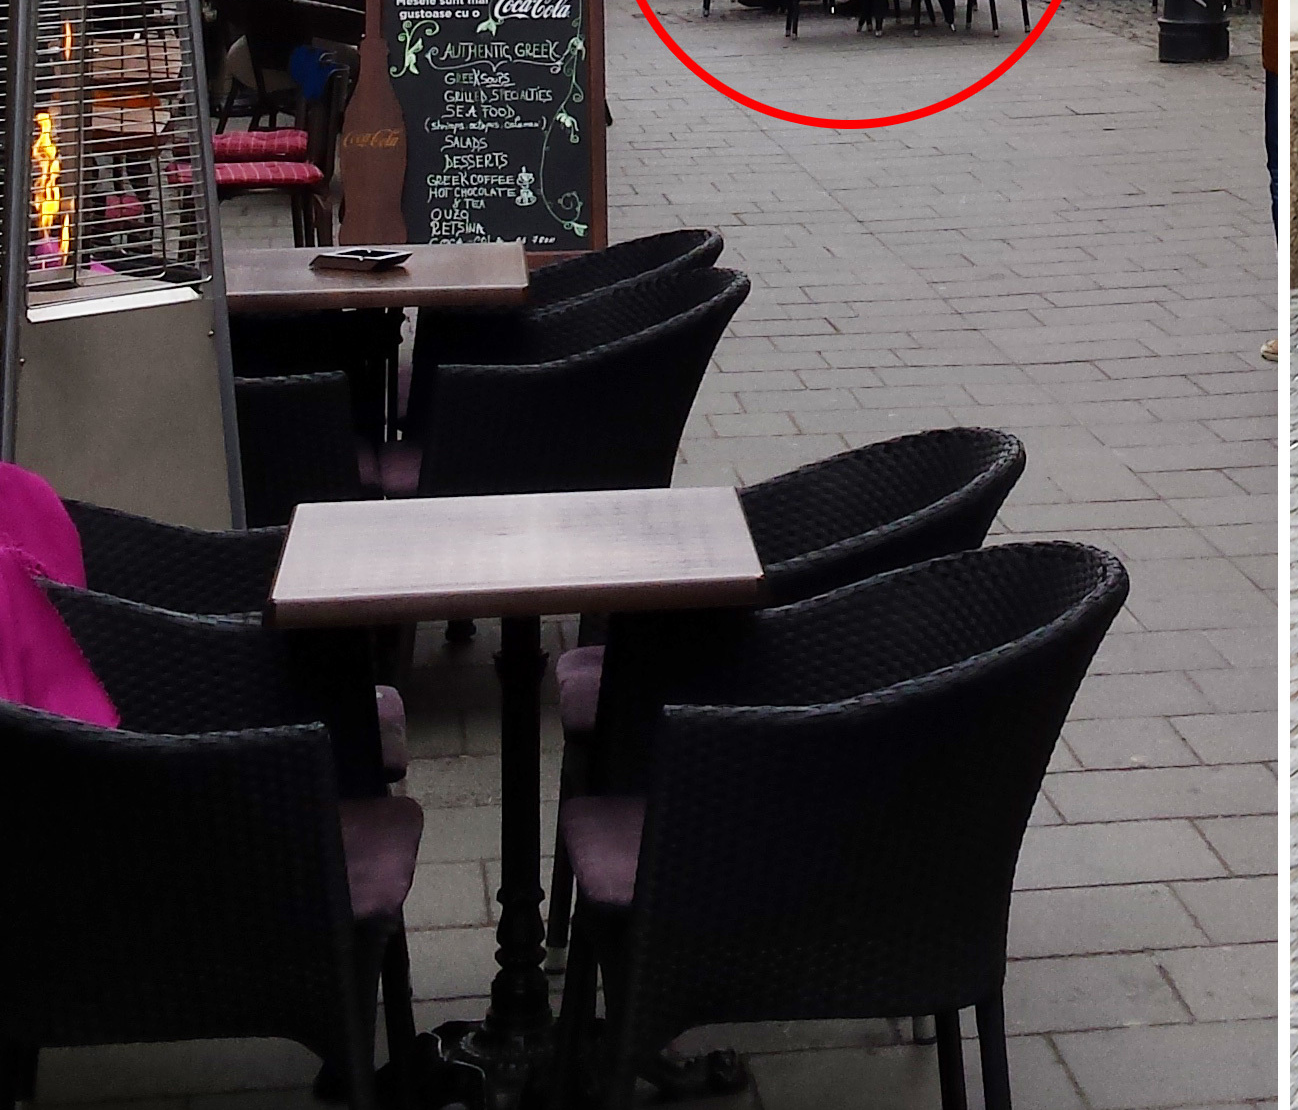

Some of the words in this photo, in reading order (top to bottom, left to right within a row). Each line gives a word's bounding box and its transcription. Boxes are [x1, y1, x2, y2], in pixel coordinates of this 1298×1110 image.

[399, 9, 452, 20] gustoase
[454, 9, 470, 18] cu
[472, 9, 480, 18] o
[439, 42, 512, 62] AUTHENTIC
[514, 40, 561, 61] GREEK
[441, 105, 477, 118] SEA
[480, 104, 516, 119] FOOD
[441, 134, 488, 152] SALADS
[443, 152, 509, 173] DESSERTS
[427, 172, 469, 186] GREEK
[470, 174, 515, 186] COFFEE
[427, 188, 452, 203] HOT
[454, 187, 516, 198] CHOCOLATE
[464, 198, 486, 209] TEA
[431, 208, 469, 221] OUZO
[430, 221, 486, 236] RETSINA
